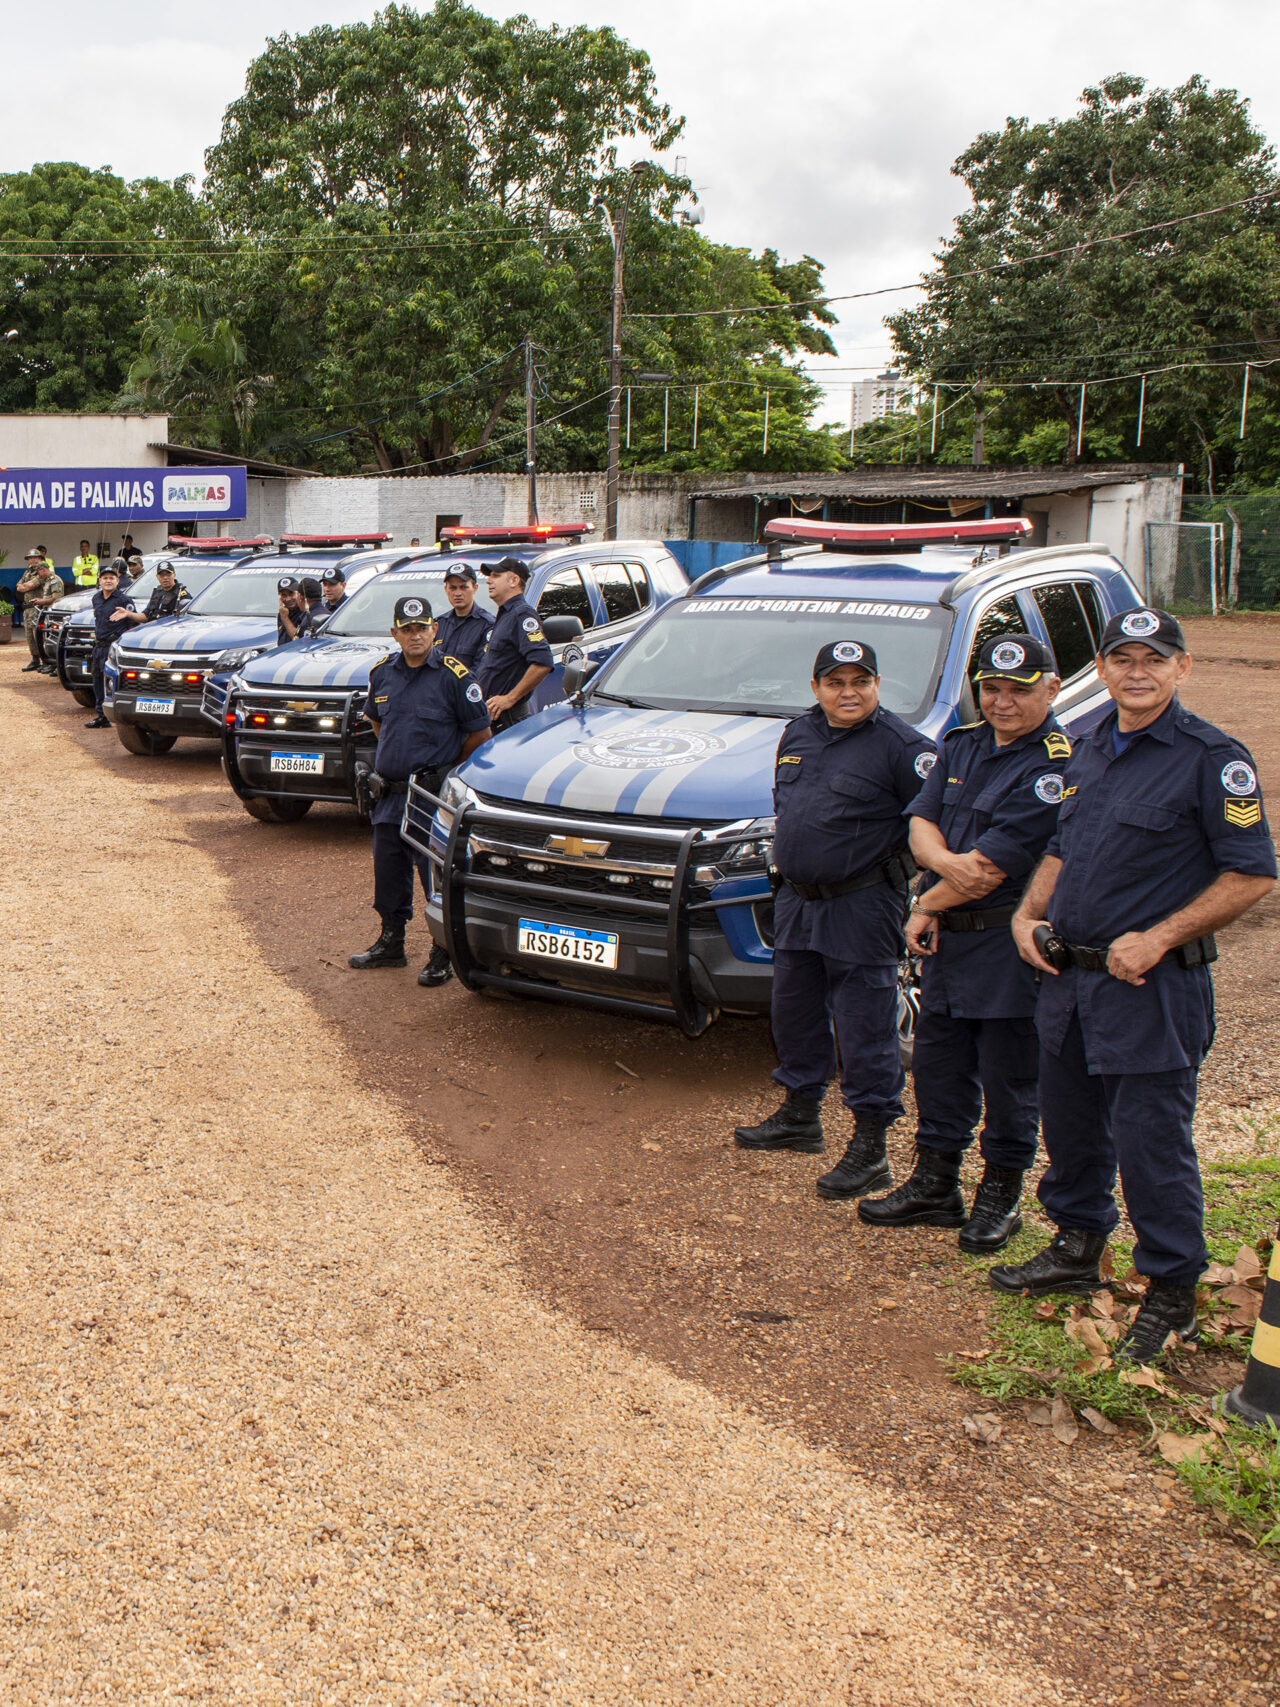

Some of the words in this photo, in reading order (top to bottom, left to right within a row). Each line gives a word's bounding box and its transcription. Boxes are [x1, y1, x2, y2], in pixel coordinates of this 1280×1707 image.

[51, 482, 76, 509] DE
[81, 481, 155, 509] PALMAS
[167, 486, 226, 501] PALMAS
[139, 702, 170, 713] RSB6H93
[275, 758, 317, 772] RSB6H84
[526, 931, 605, 963] RSB6I52
